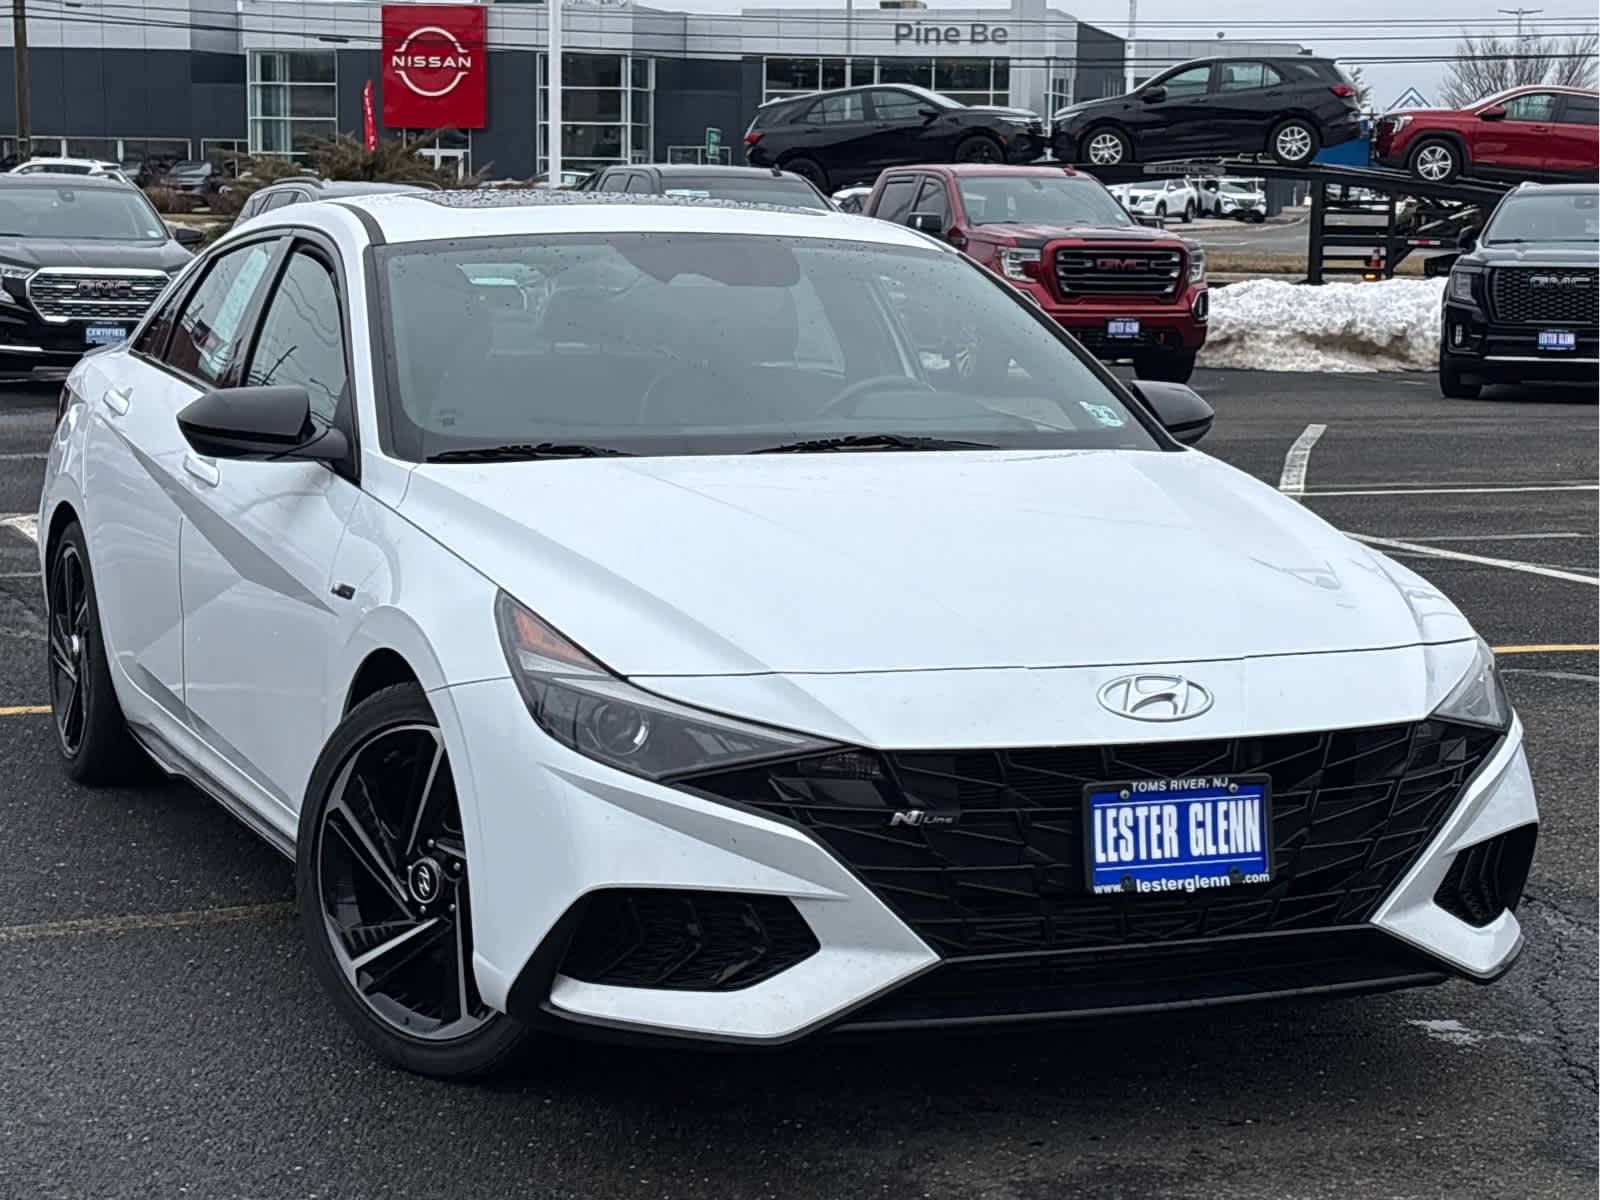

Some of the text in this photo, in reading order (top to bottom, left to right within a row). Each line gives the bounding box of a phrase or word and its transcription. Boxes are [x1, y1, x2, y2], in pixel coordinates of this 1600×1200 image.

[895, 21, 1009, 45] Pine Be
[392, 55, 472, 68] NISSAN
[1096, 258, 1148, 270] GMC
[1530, 276, 1591, 289] GMC
[86, 328, 126, 337] CERTIFIED
[1131, 777, 1229, 793] TOMS RIVER, NJ
[1094, 799, 1262, 864] LESTER GLENN
[1136, 874, 1231, 893] lesterglenn
